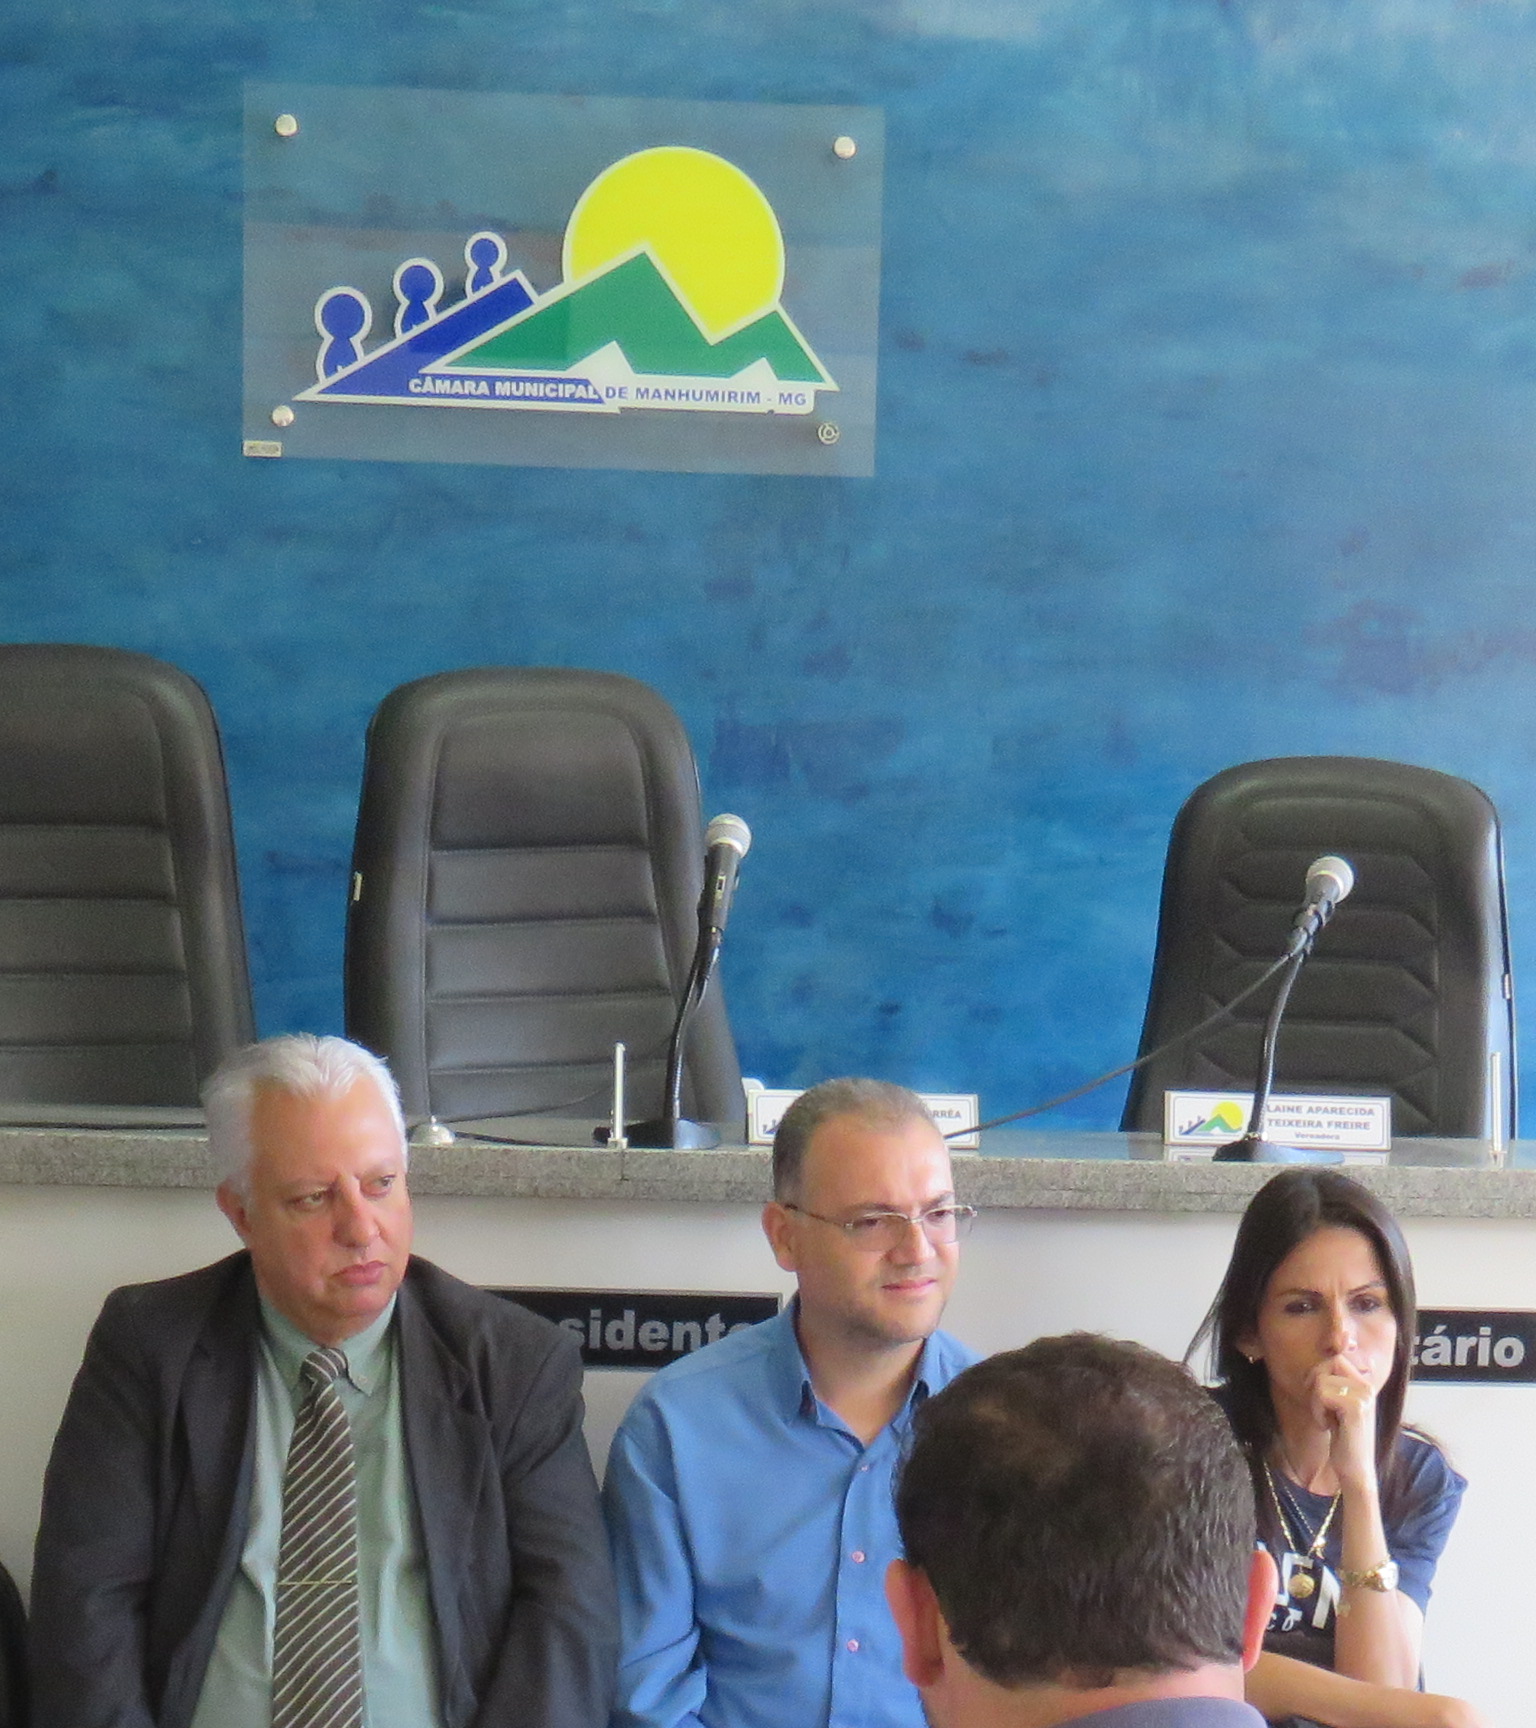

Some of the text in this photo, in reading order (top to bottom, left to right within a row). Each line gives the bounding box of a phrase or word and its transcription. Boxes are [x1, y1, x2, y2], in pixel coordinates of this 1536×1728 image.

[408, 376, 490, 396] CÂMARA
[495, 381, 598, 399] MUNICIPAL
[605, 386, 628, 399] DE
[635, 387, 761, 405] MANHUMIRIM
[778, 392, 807, 406] MG
[1266, 1104, 1375, 1116] LAINE APARECIDA
[1267, 1118, 1371, 1131] TEIXEIRA FREIRE
